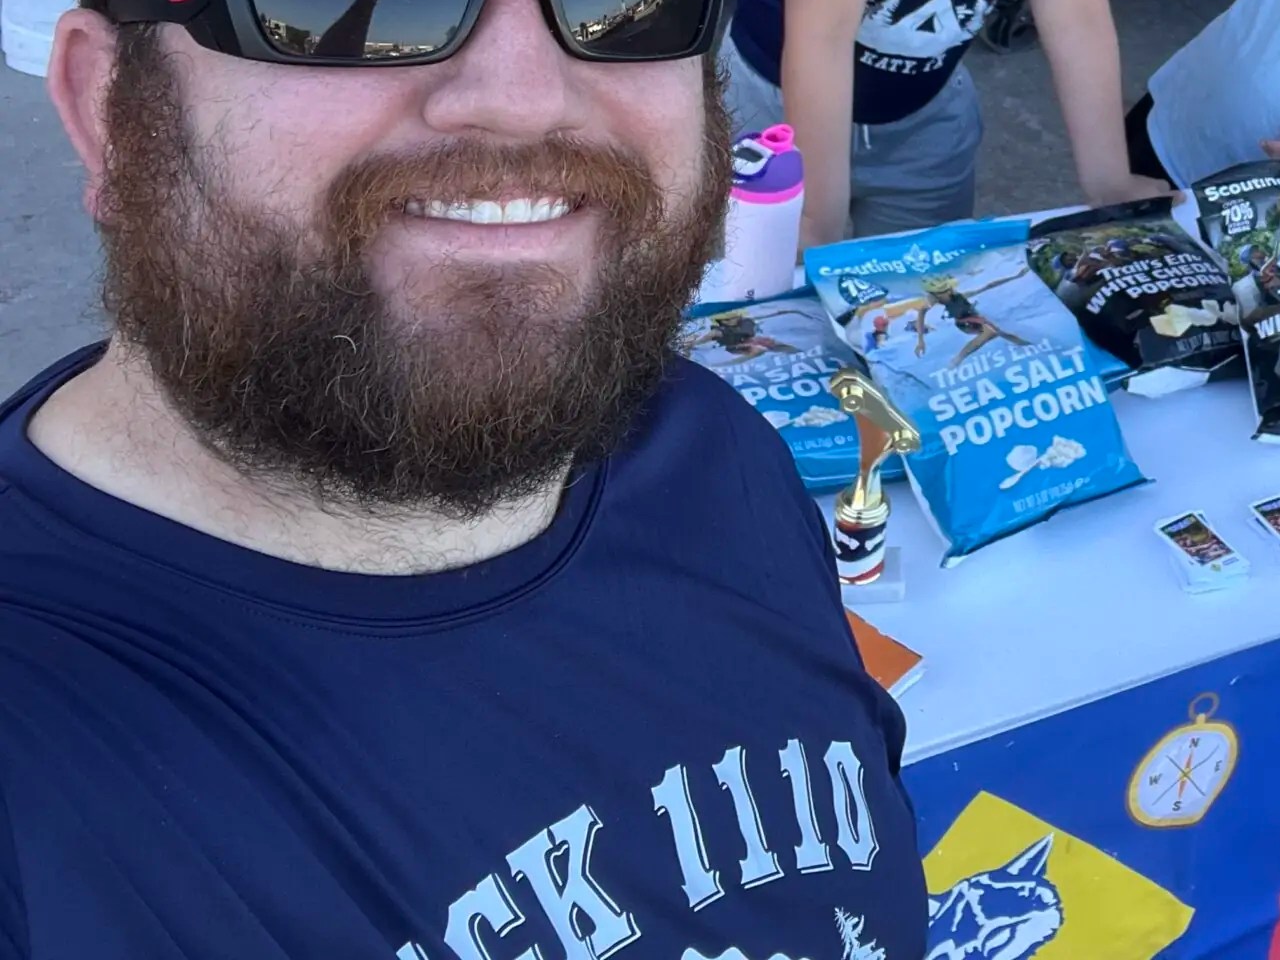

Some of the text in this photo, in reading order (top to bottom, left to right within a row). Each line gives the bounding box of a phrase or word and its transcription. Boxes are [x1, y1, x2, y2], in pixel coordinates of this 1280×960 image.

[860, 50, 916, 75] KATY,
[1221, 201, 1254, 225] 70%
[1096, 258, 1163, 282] Trail's
[1086, 272, 1149, 315] WHITE
[1126, 276, 1227, 299] POPCORN
[929, 339, 1052, 388] Trail's End
[928, 345, 1085, 422] SEA SALT
[939, 376, 1107, 456] POPCORN
[1189, 737, 1200, 749] N
[1149, 773, 1163, 786] W
[1172, 800, 1182, 812] S
[396, 738, 879, 960] CK 1110
